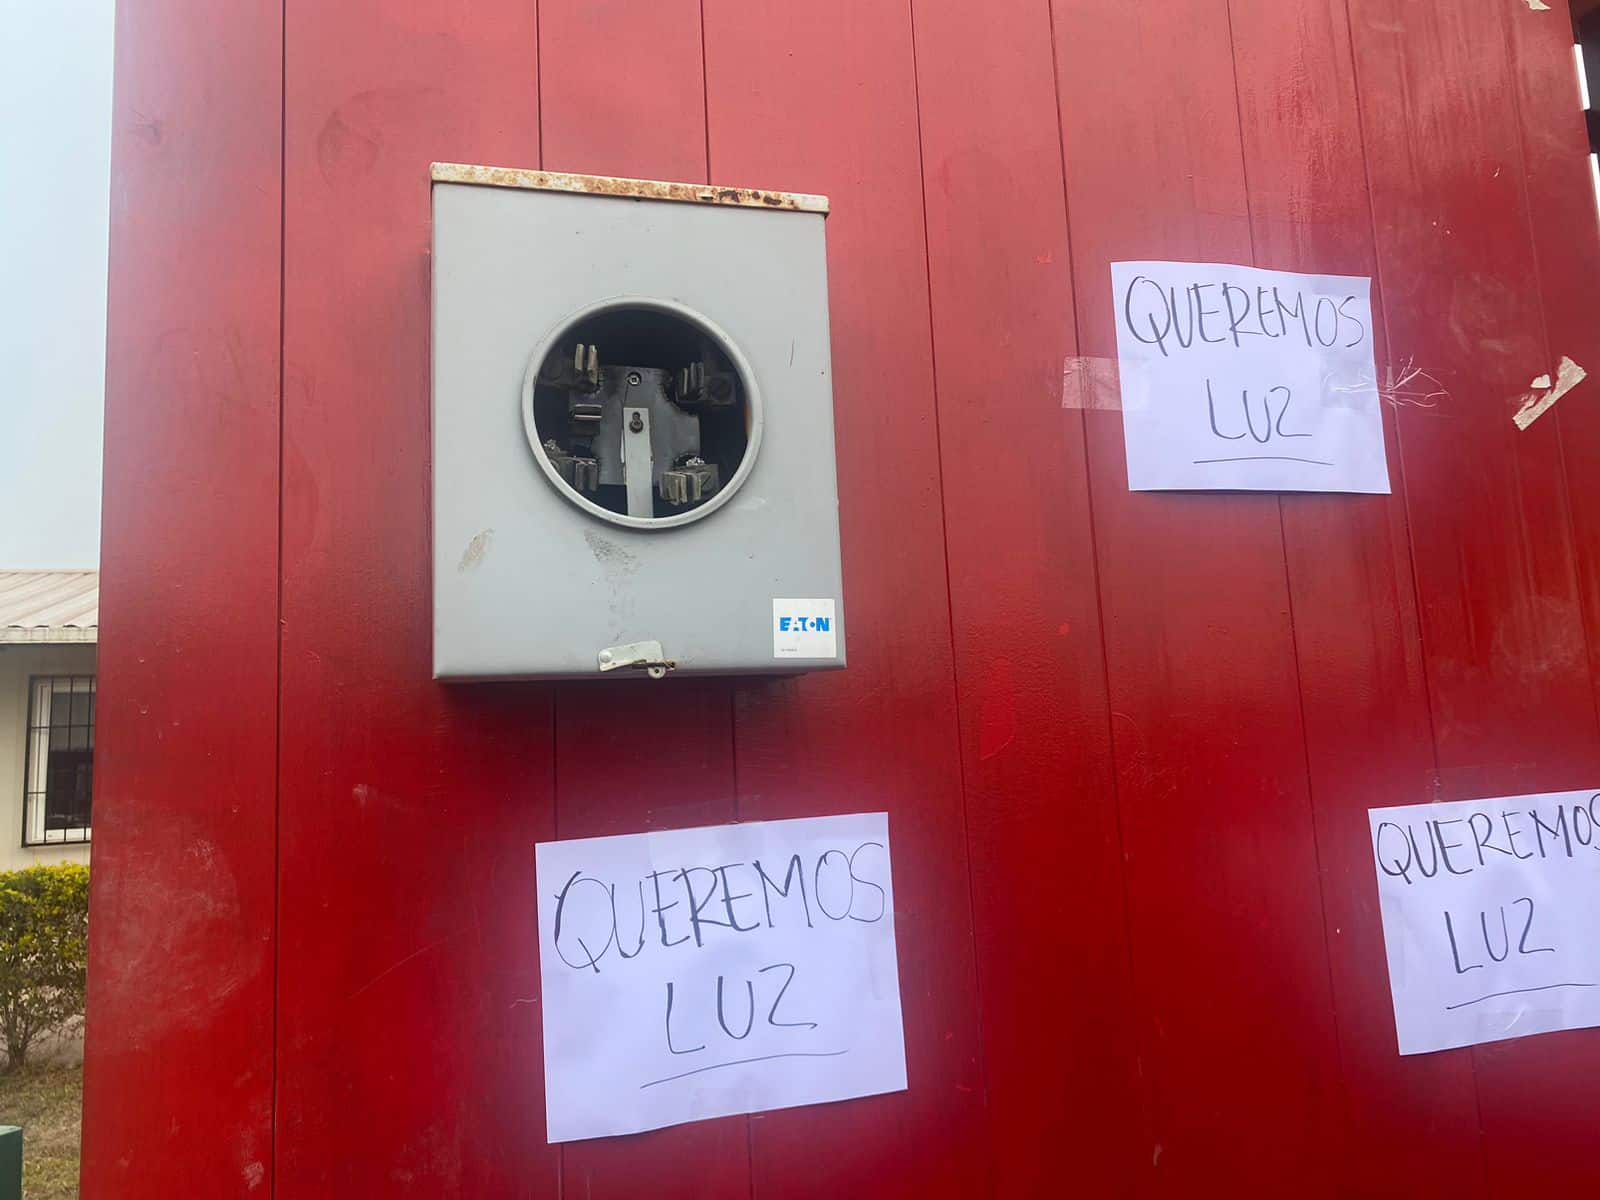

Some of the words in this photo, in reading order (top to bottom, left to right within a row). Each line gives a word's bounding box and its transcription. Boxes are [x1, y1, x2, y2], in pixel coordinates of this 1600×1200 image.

[1125, 275, 1364, 357] QUEREMOS
[1206, 378, 1313, 444] LUZ
[779, 616, 831, 632] EATON
[554, 842, 885, 973] QUEREMOS
[1444, 897, 1556, 975] LUZ
[665, 963, 818, 1055] LUZ
